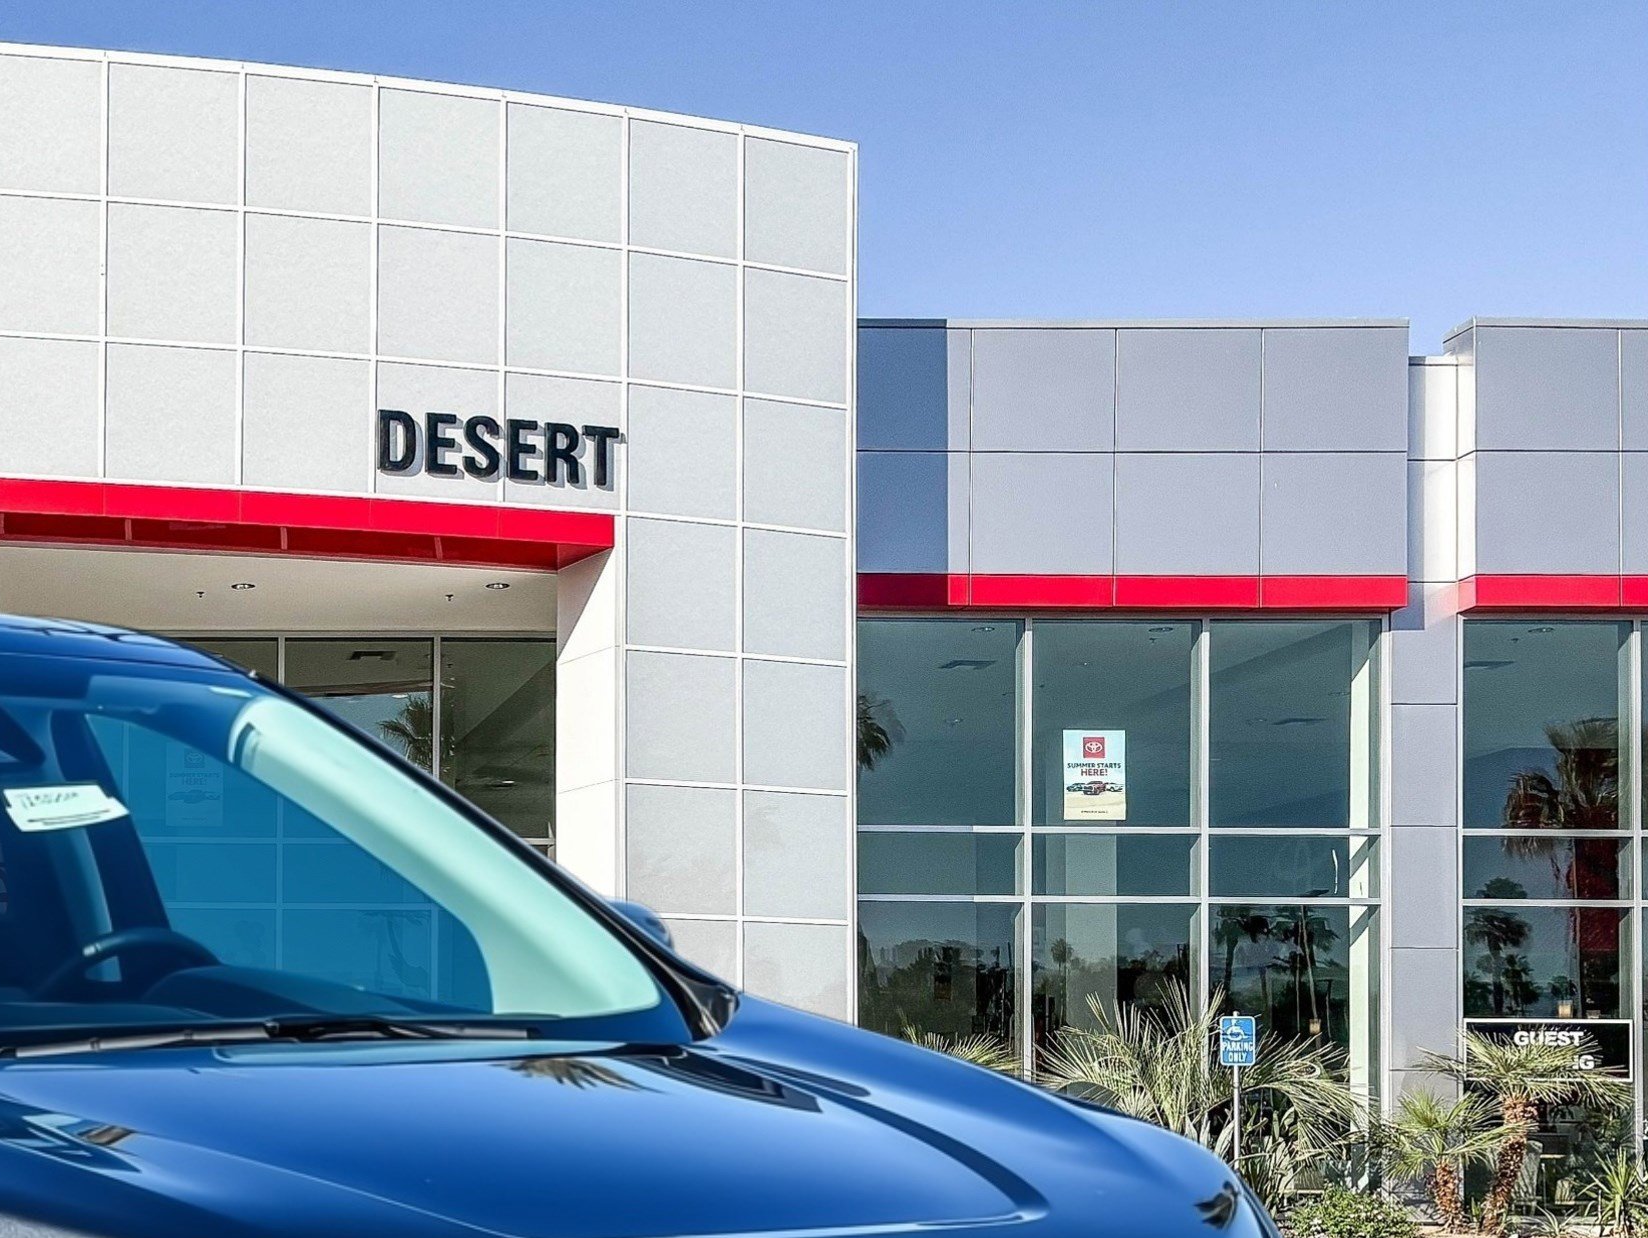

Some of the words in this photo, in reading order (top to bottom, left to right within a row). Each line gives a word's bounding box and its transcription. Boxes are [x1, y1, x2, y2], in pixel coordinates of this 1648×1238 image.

[377, 409, 620, 487] DESERT
[1080, 768, 1108, 776] HERE!
[1513, 1030, 1584, 1047] GUEST
[1222, 1041, 1253, 1051] PARKING
[1228, 1052, 1247, 1063] ONLY
